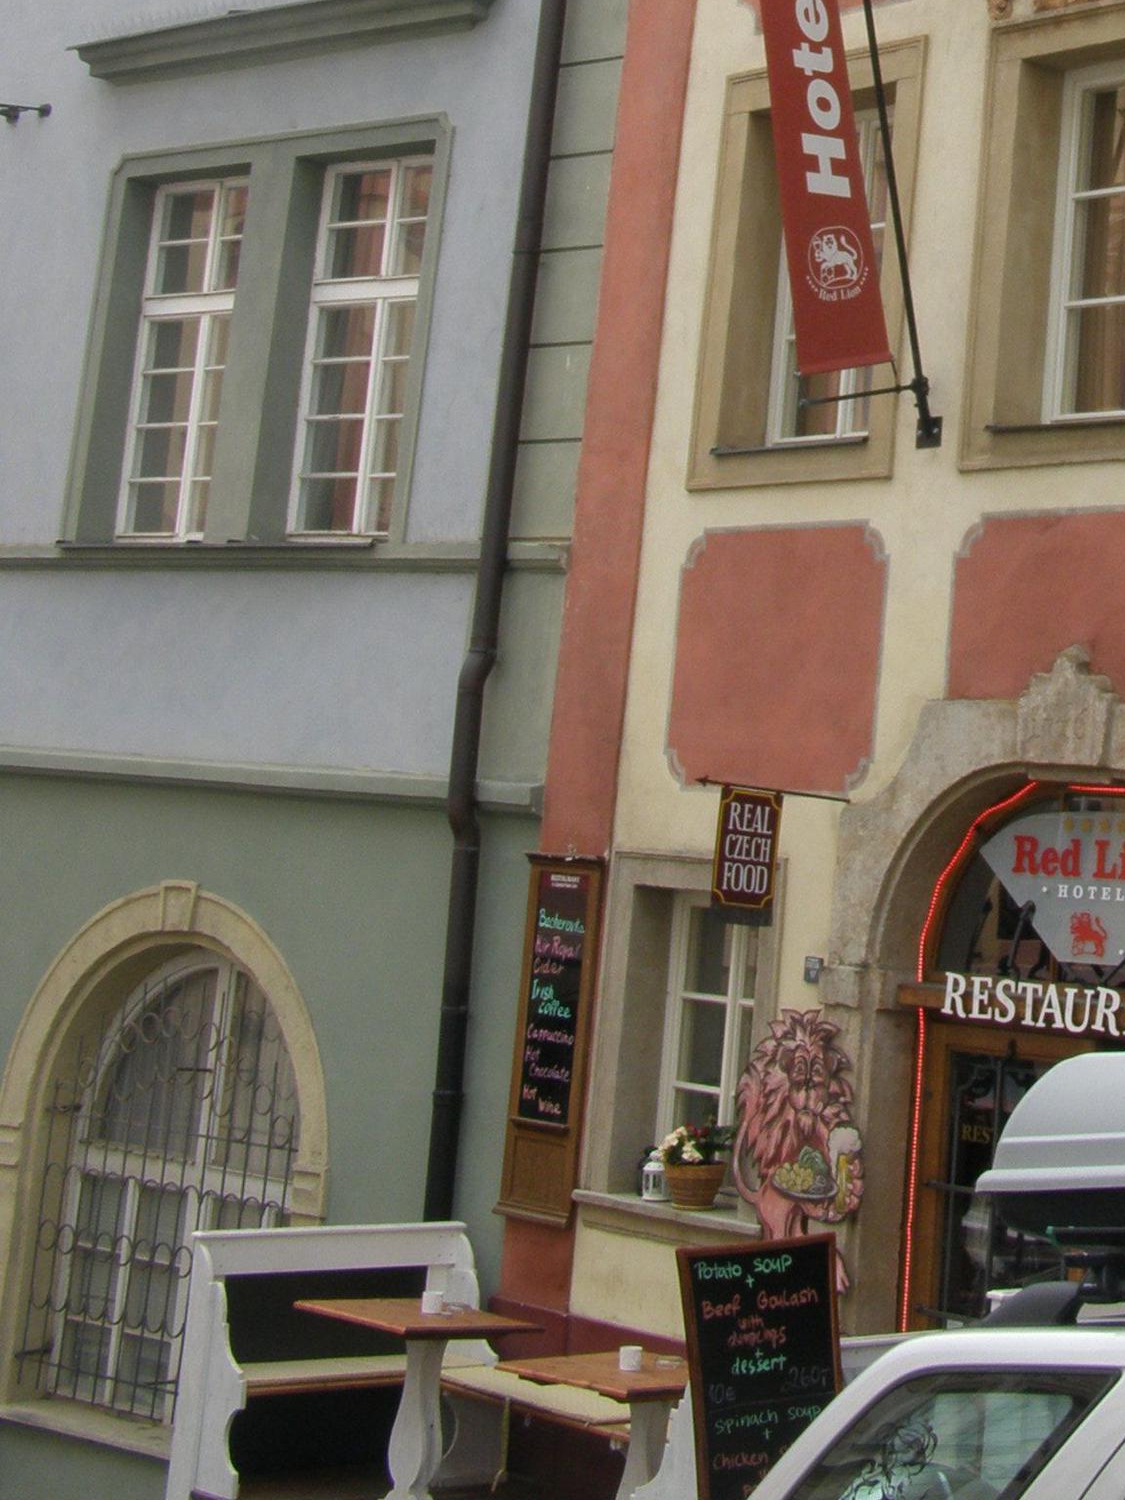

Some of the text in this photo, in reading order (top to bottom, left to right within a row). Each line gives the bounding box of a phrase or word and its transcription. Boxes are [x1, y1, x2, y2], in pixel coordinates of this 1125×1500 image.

[727, 801, 772, 835] REAL
[724, 833, 772, 863] CZECH
[1011, 835, 1083, 878] Red
[721, 861, 768, 894] FOOD
[1057, 884, 1125, 901] HOTEL
[694, 1260, 743, 1280] Potato
[701, 1293, 742, 1320] Beef
[731, 1353, 788, 1376] dessert
